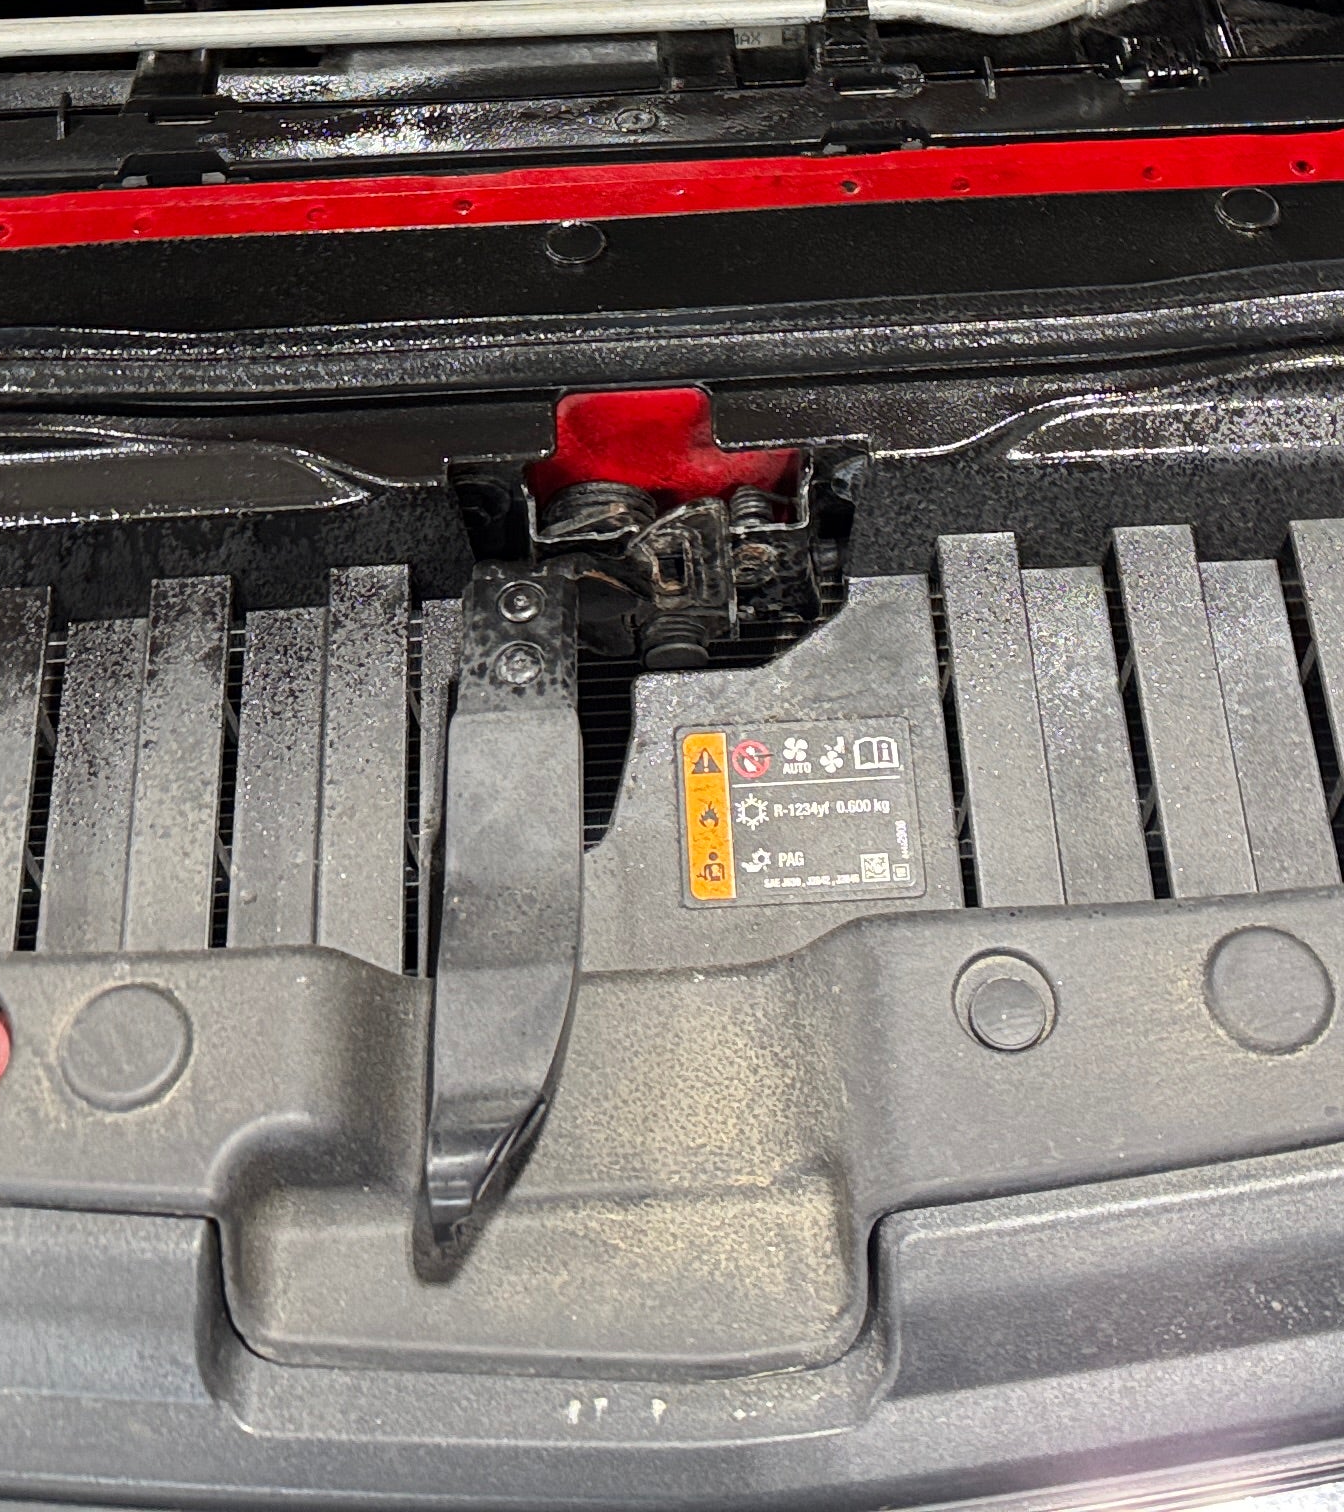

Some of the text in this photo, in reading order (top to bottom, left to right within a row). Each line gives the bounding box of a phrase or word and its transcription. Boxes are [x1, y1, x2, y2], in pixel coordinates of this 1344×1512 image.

[782, 762, 812, 775] AUTO
[773, 798, 890, 818] R-1234yf 0.600 kg
[778, 851, 805, 868] PAG
